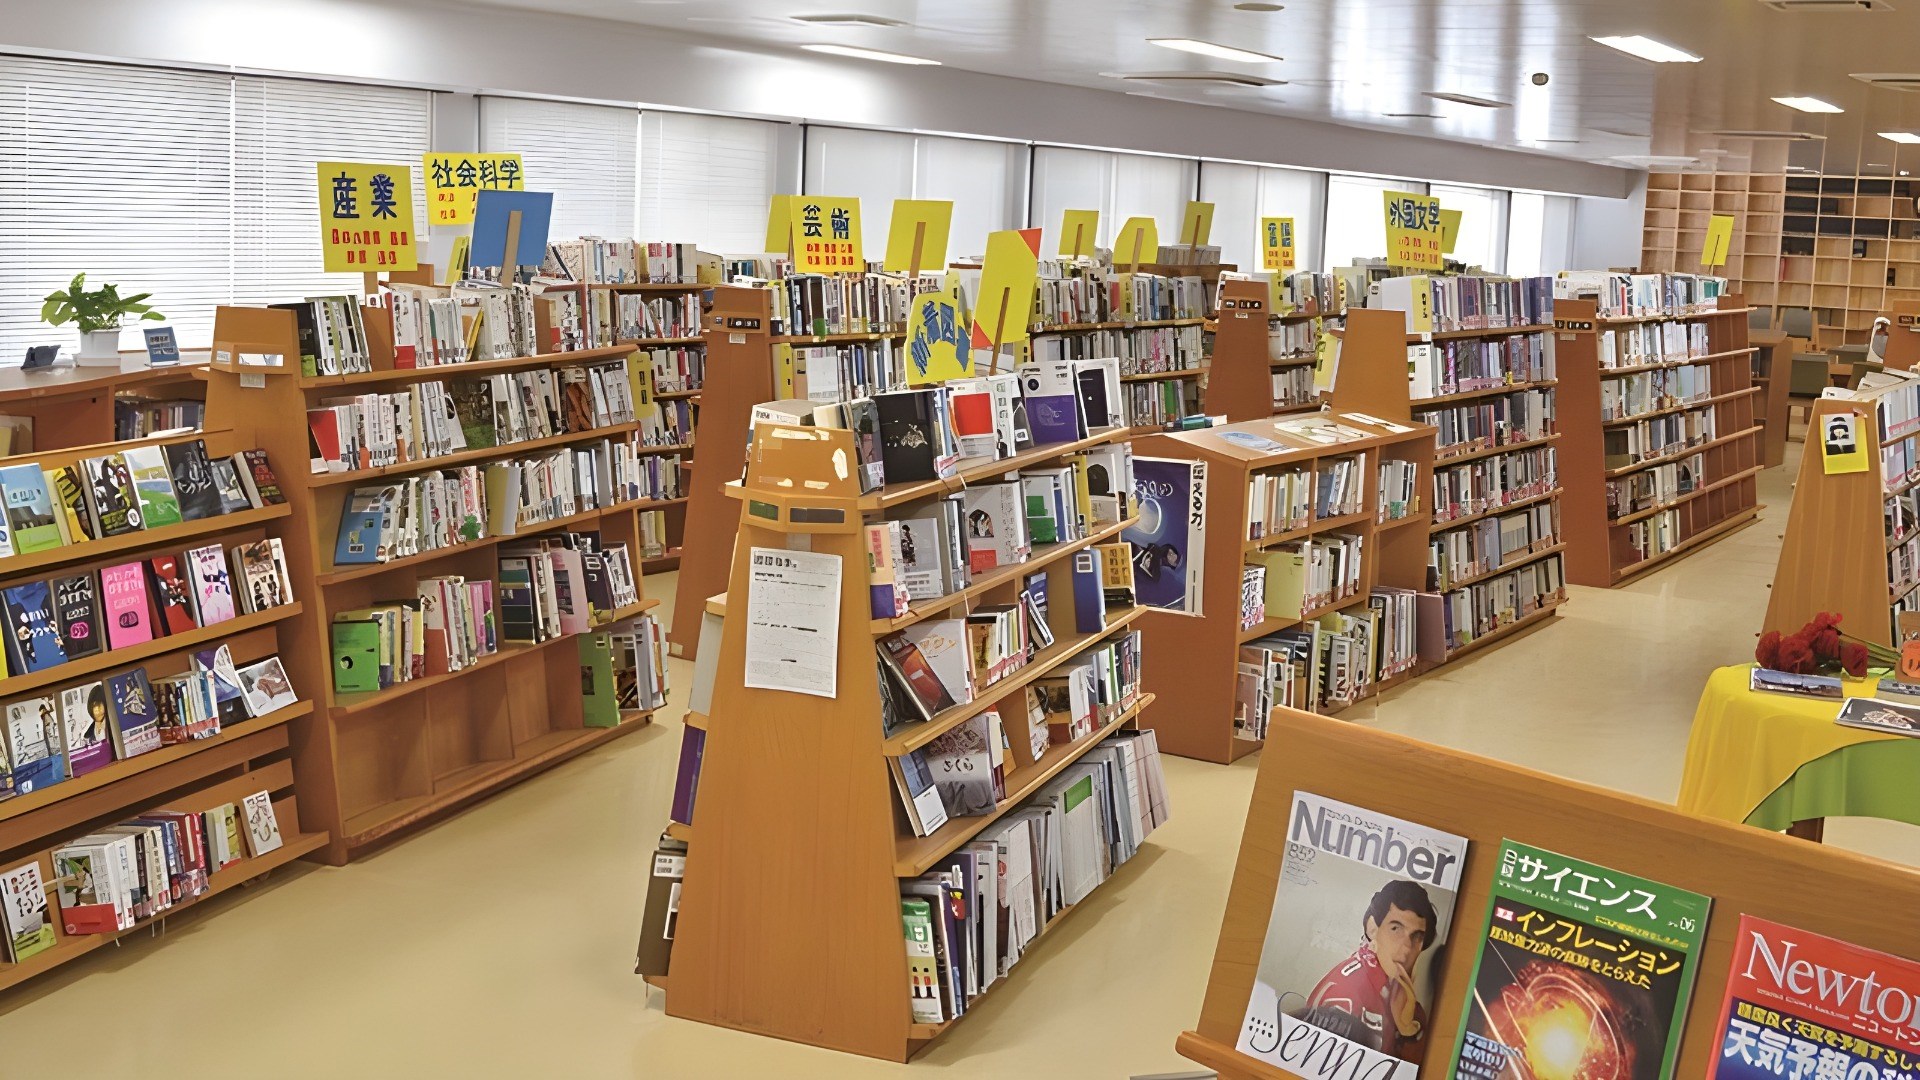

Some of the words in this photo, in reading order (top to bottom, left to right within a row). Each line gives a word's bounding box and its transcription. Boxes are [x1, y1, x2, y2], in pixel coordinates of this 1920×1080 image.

[332, 171, 397, 220] 産業
[432, 158, 521, 189] 社会科学
[1292, 799, 1456, 886] Number
[1518, 855, 1658, 921] サイエンス
[1516, 910, 1681, 975] インフレーション
